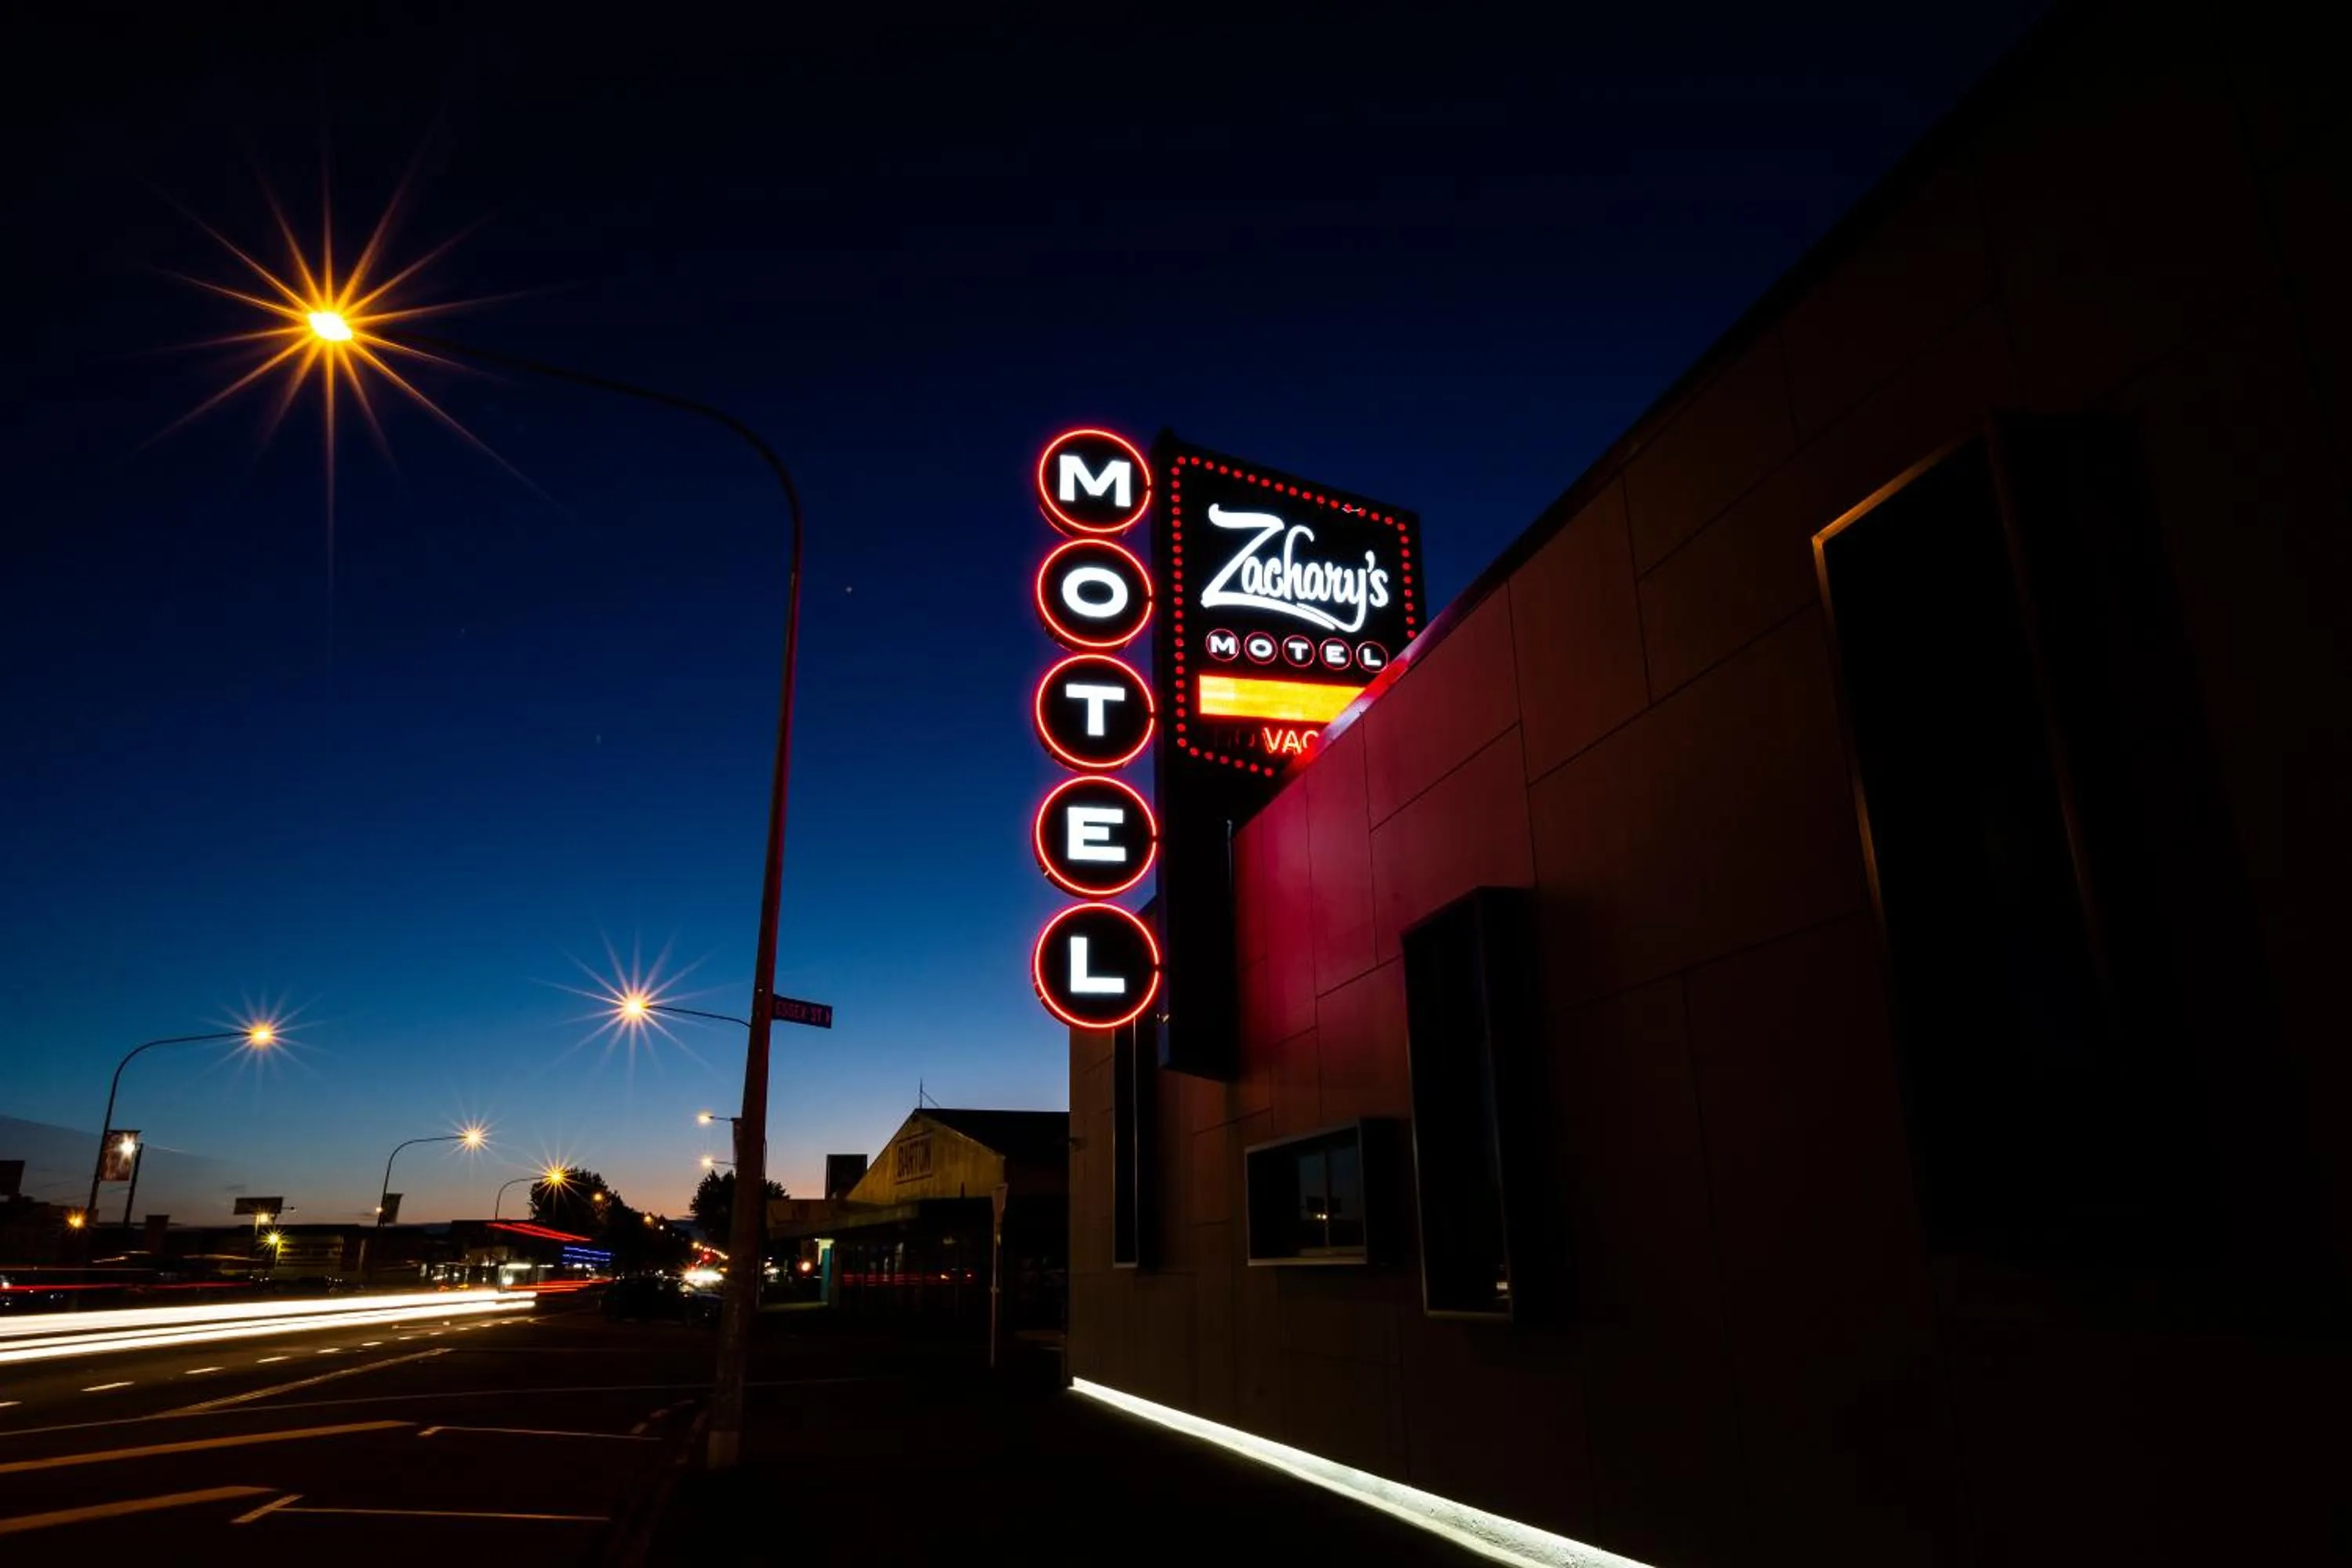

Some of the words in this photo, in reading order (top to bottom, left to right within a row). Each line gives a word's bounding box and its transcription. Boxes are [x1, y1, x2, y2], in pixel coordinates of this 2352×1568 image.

[1200, 503, 1389, 633] Zachary's
[1210, 635, 1382, 667] MOTEL
[1058, 453, 1132, 993] MOTEL
[810, 1006, 823, 1024] ST
